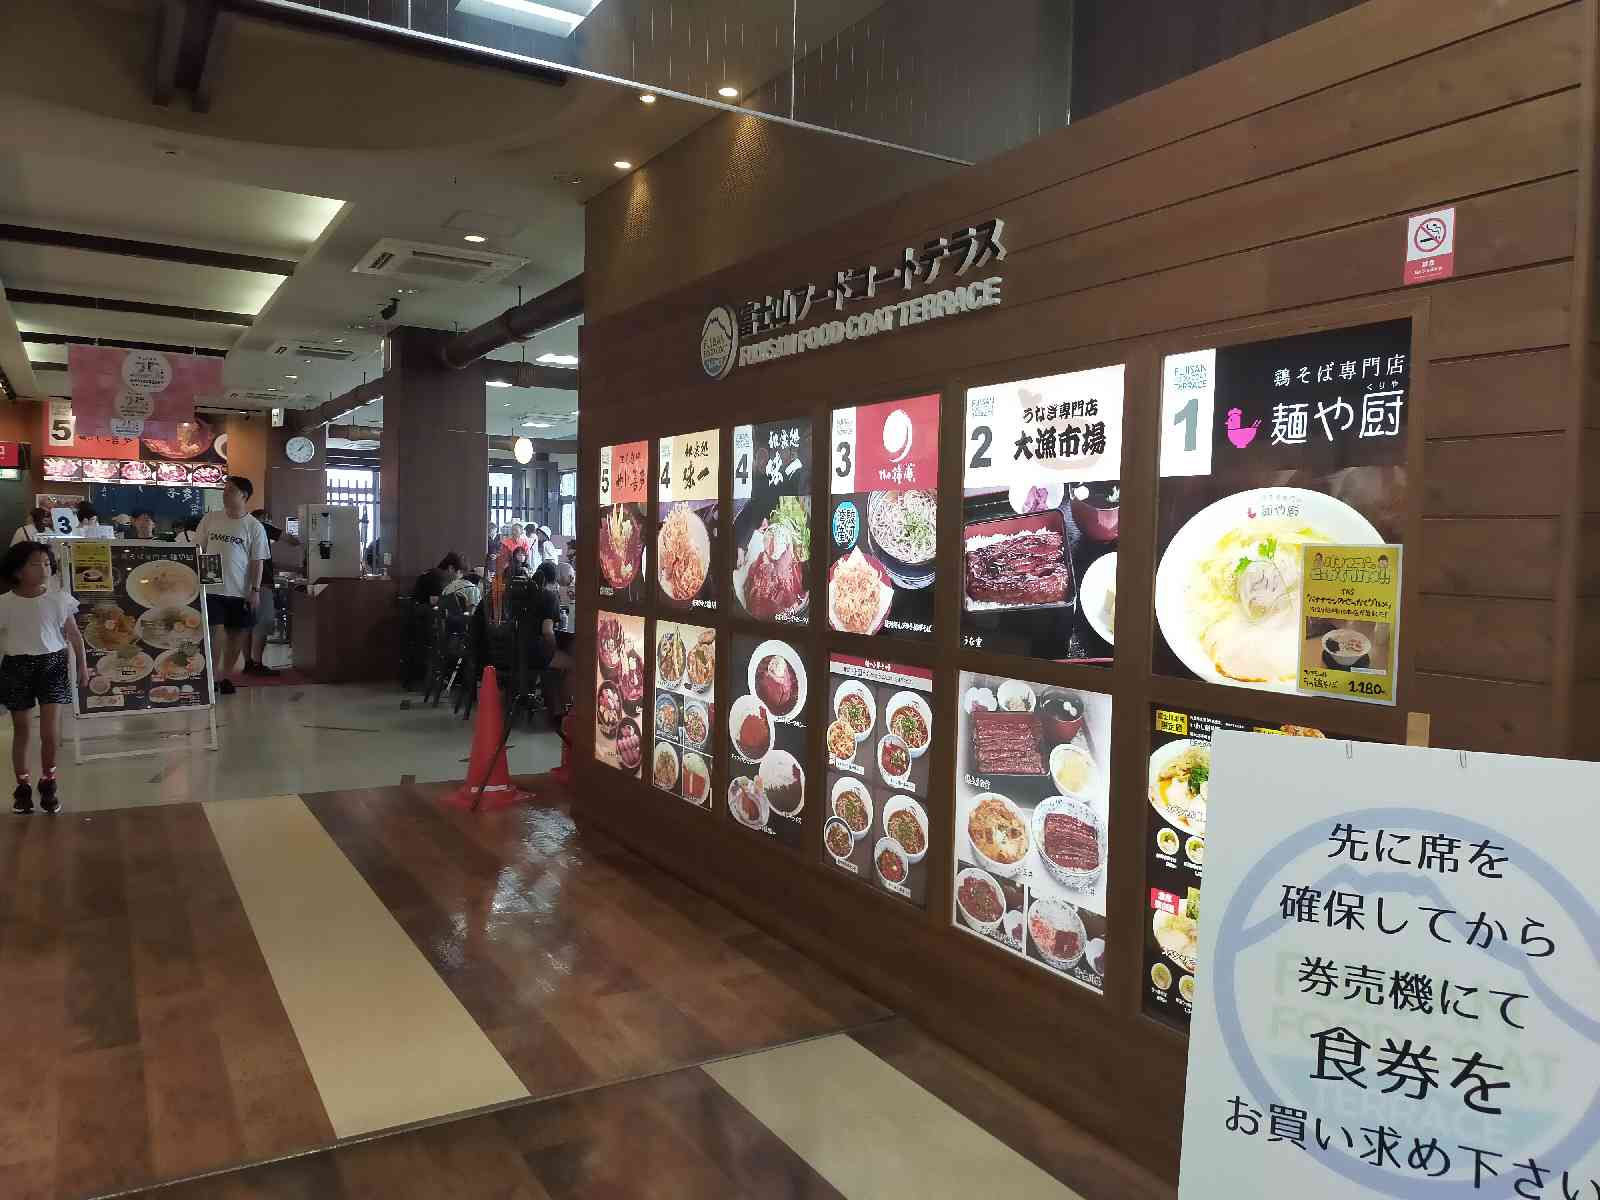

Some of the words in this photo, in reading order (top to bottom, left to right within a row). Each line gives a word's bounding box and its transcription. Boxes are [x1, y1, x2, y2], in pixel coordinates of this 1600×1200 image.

[739, 217, 1007, 337] 富士山フードコートテラス
[798, 321, 845, 352] FOOD
[845, 305, 897, 340] COAT
[898, 276, 1003, 327] TERRACE
[1273, 354, 1406, 387] 鶏そば専門店
[1366, 380, 1400, 391] くりや
[51, 419, 72, 441] 5
[1023, 398, 1098, 424] うなぎ専門店
[1173, 398, 1199, 452] 1
[1270, 390, 1405, 446] 麺や厨
[836, 441, 852, 478] 3
[970, 425, 993, 469] 2
[1013, 421, 1106, 461] 大漁市場
[601, 468, 610, 494] 5
[660, 461, 671, 489] 4
[735, 454, 749, 485] 4
[57, 515, 73, 535] 3
[1328, 824, 1509, 879] 先に席を
[1280, 884, 1556, 958] 確保してから
[1299, 956, 1529, 1029] 券売機にて
[1310, 1026, 1511, 1115] 食券を
[1225, 1096, 1600, 1200] お買い求め下さい
